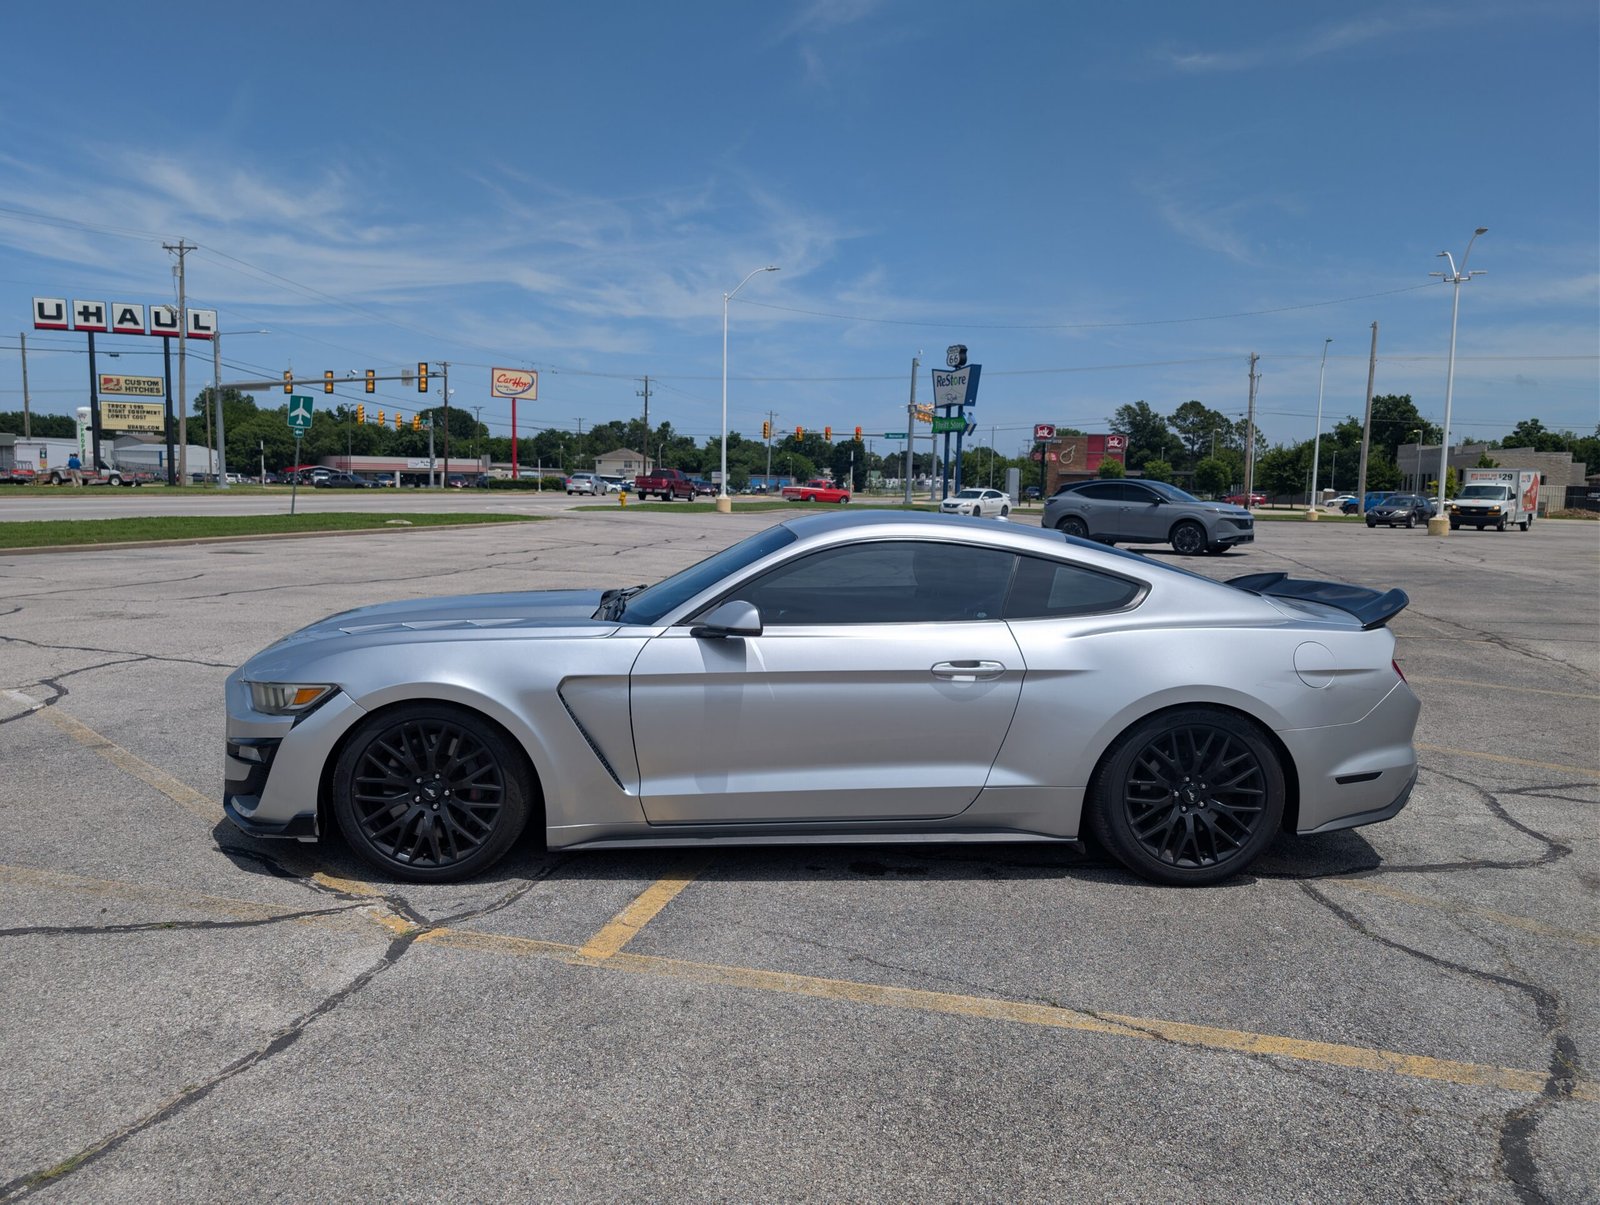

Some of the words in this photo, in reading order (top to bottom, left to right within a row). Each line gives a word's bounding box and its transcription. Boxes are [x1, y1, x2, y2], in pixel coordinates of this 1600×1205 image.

[949, 354, 958, 364] 66
[124, 379, 159, 387] CUSTOM
[937, 374, 966, 387] ReStore
[125, 386, 161, 394] HITCHES
